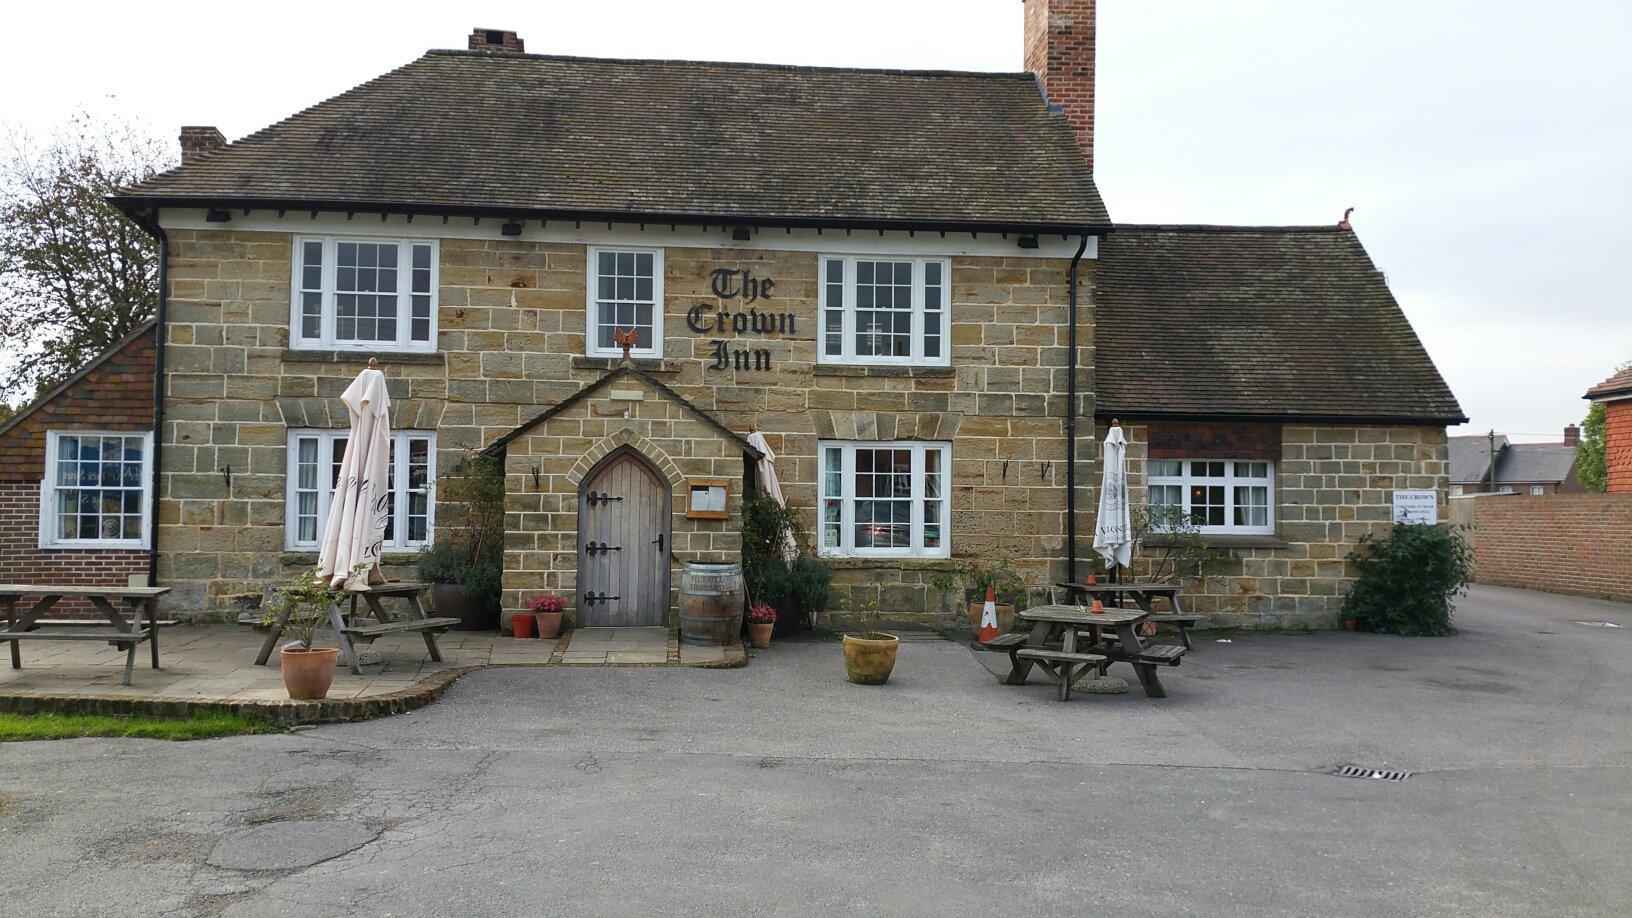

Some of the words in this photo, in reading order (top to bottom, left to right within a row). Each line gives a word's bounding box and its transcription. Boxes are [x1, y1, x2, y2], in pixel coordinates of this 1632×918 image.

[710, 268, 775, 305] The
[687, 303, 797, 334] Crown
[708, 340, 772, 371] Inn
